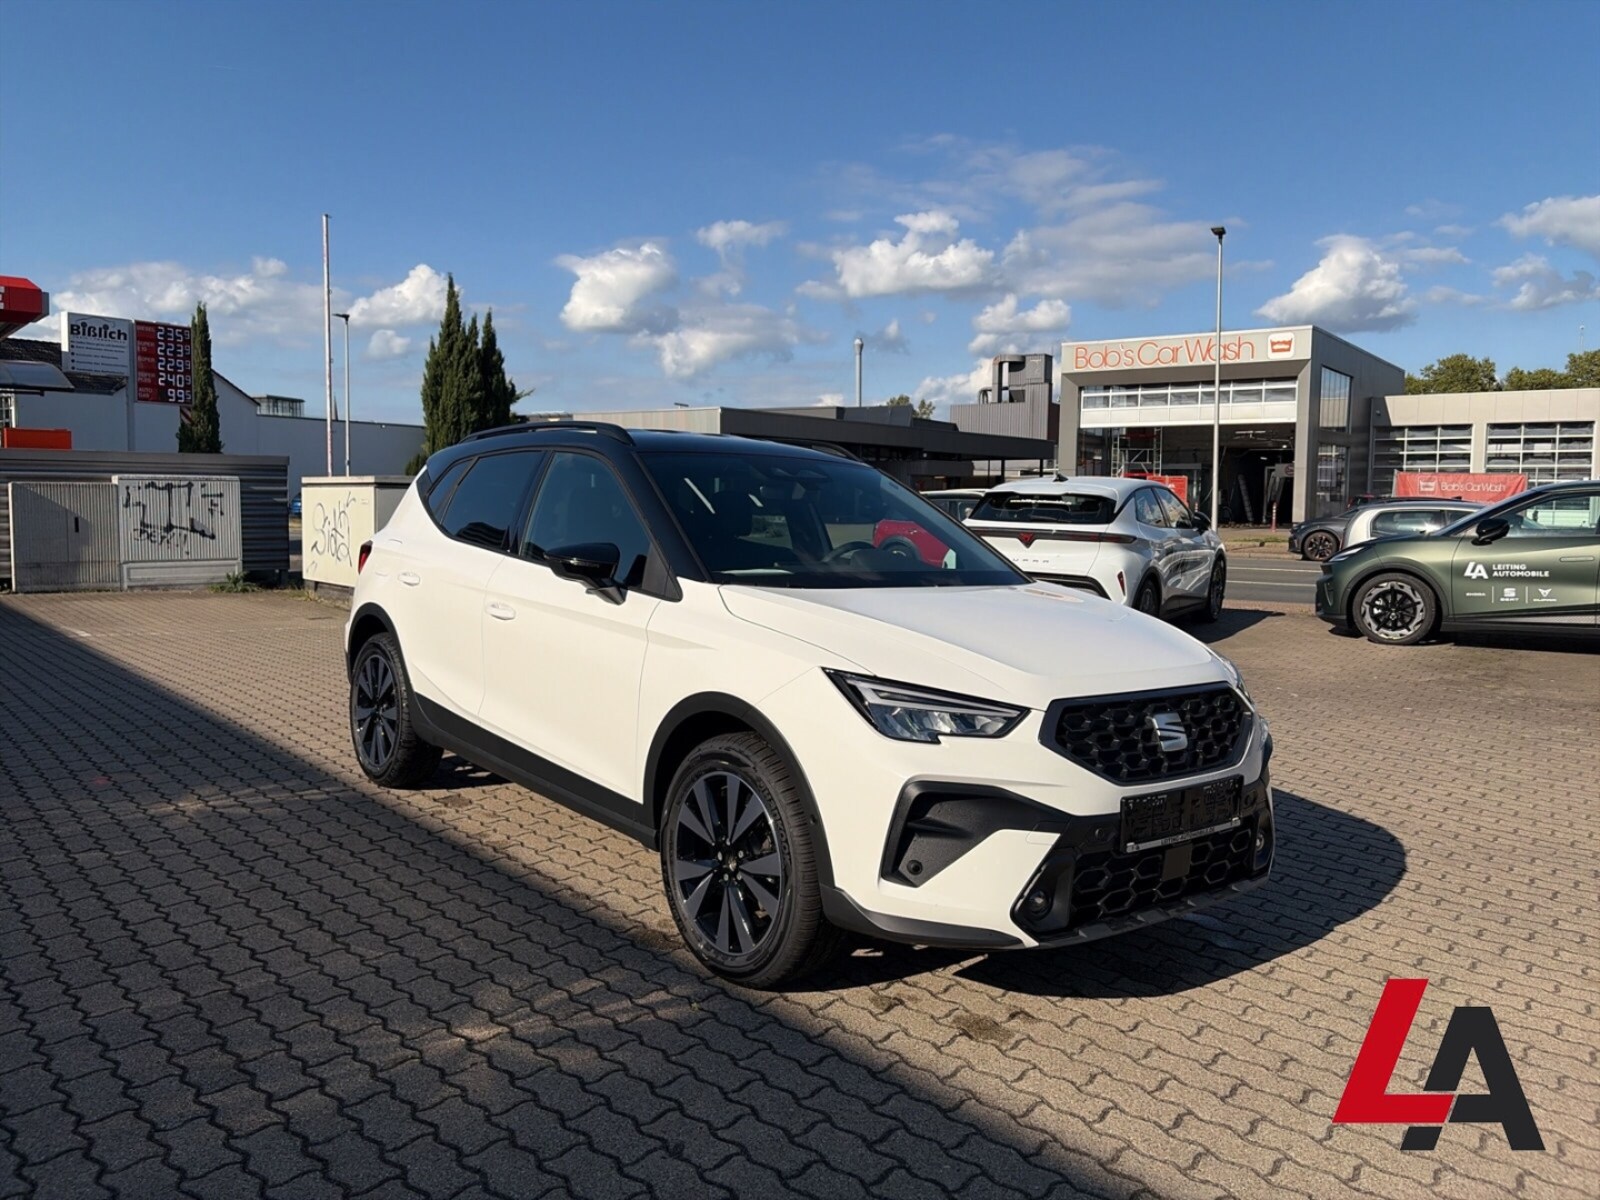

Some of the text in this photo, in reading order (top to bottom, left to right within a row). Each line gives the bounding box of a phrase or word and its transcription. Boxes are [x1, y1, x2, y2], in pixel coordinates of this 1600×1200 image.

[70, 321, 128, 341] Bißlich
[1074, 336, 1255, 370] Bob's Car Wash
[1465, 482, 1480, 492] Car
[1481, 482, 1506, 492] Wash
